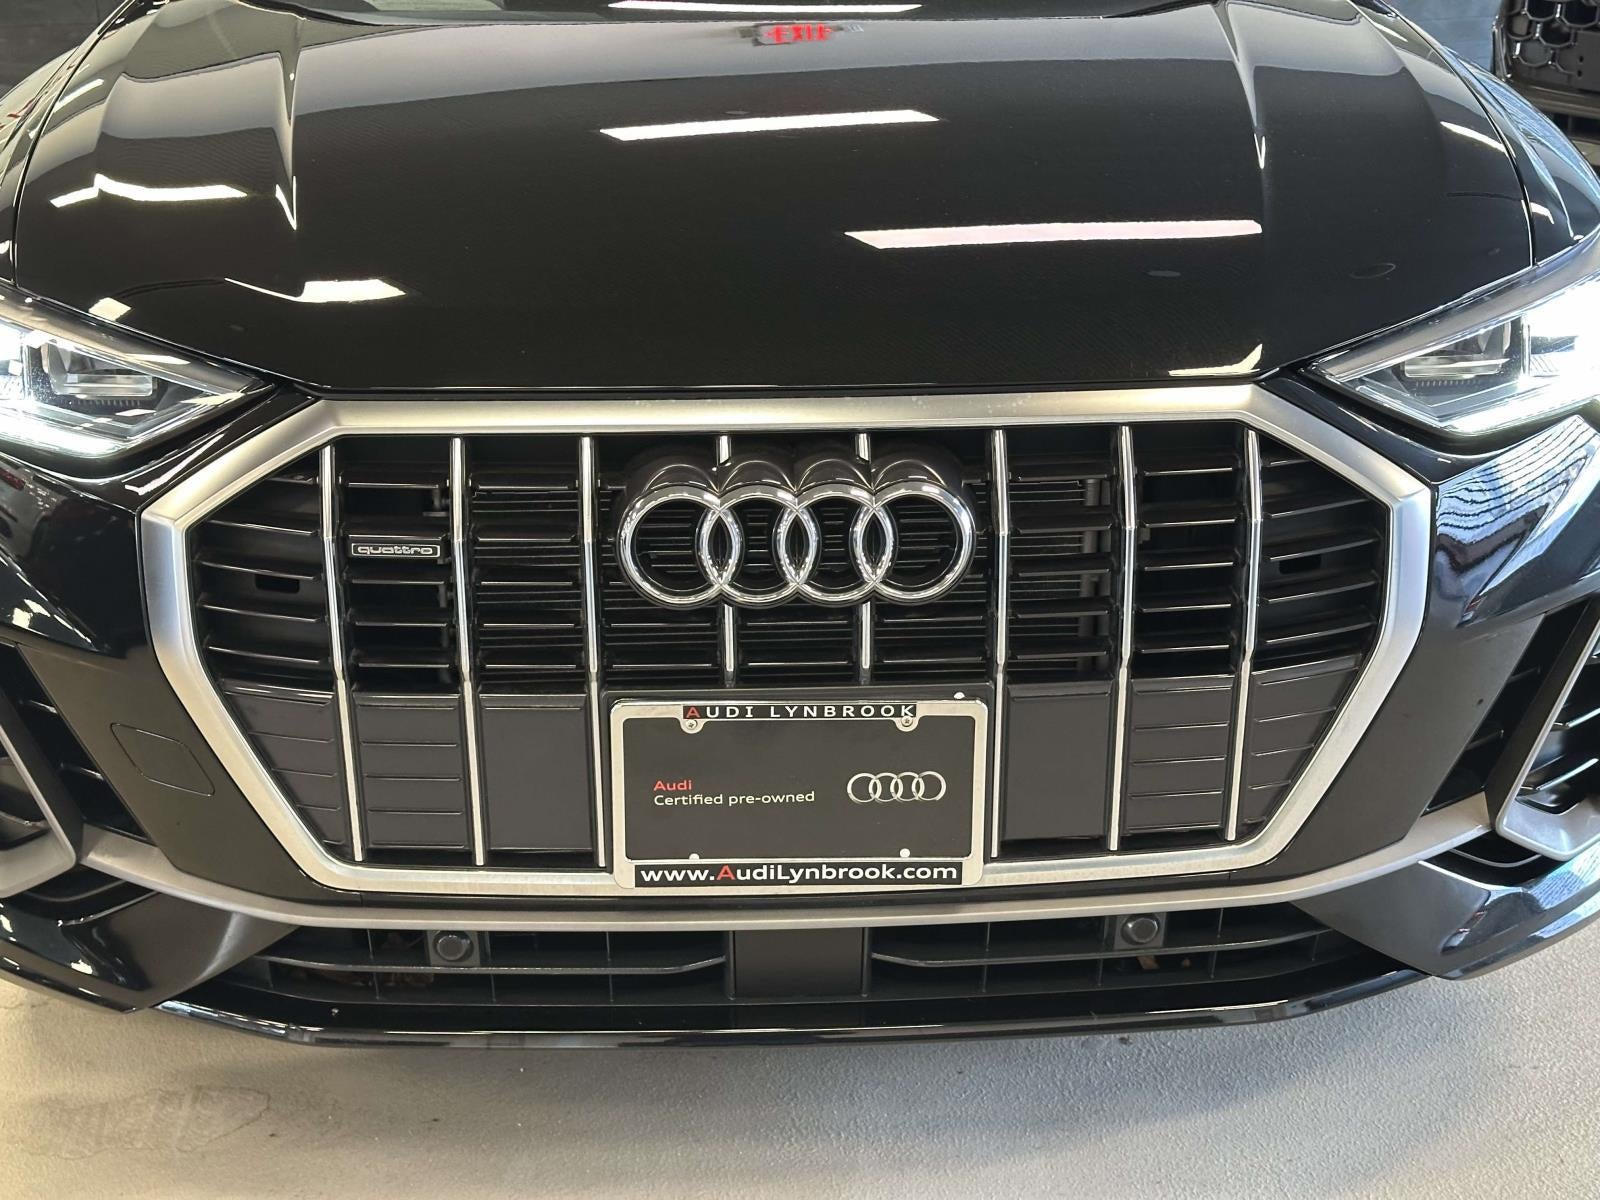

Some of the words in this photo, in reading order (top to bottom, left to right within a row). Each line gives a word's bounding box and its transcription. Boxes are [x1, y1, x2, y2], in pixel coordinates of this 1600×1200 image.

[357, 545, 433, 555] quattro
[686, 705, 754, 719] AUDI
[770, 704, 914, 718] LYNBROOK
[653, 780, 693, 791] Audi
[654, 794, 723, 806] Certified
[728, 791, 815, 806] pre-owned
[640, 864, 957, 884] www.AudiLynbrook.com
